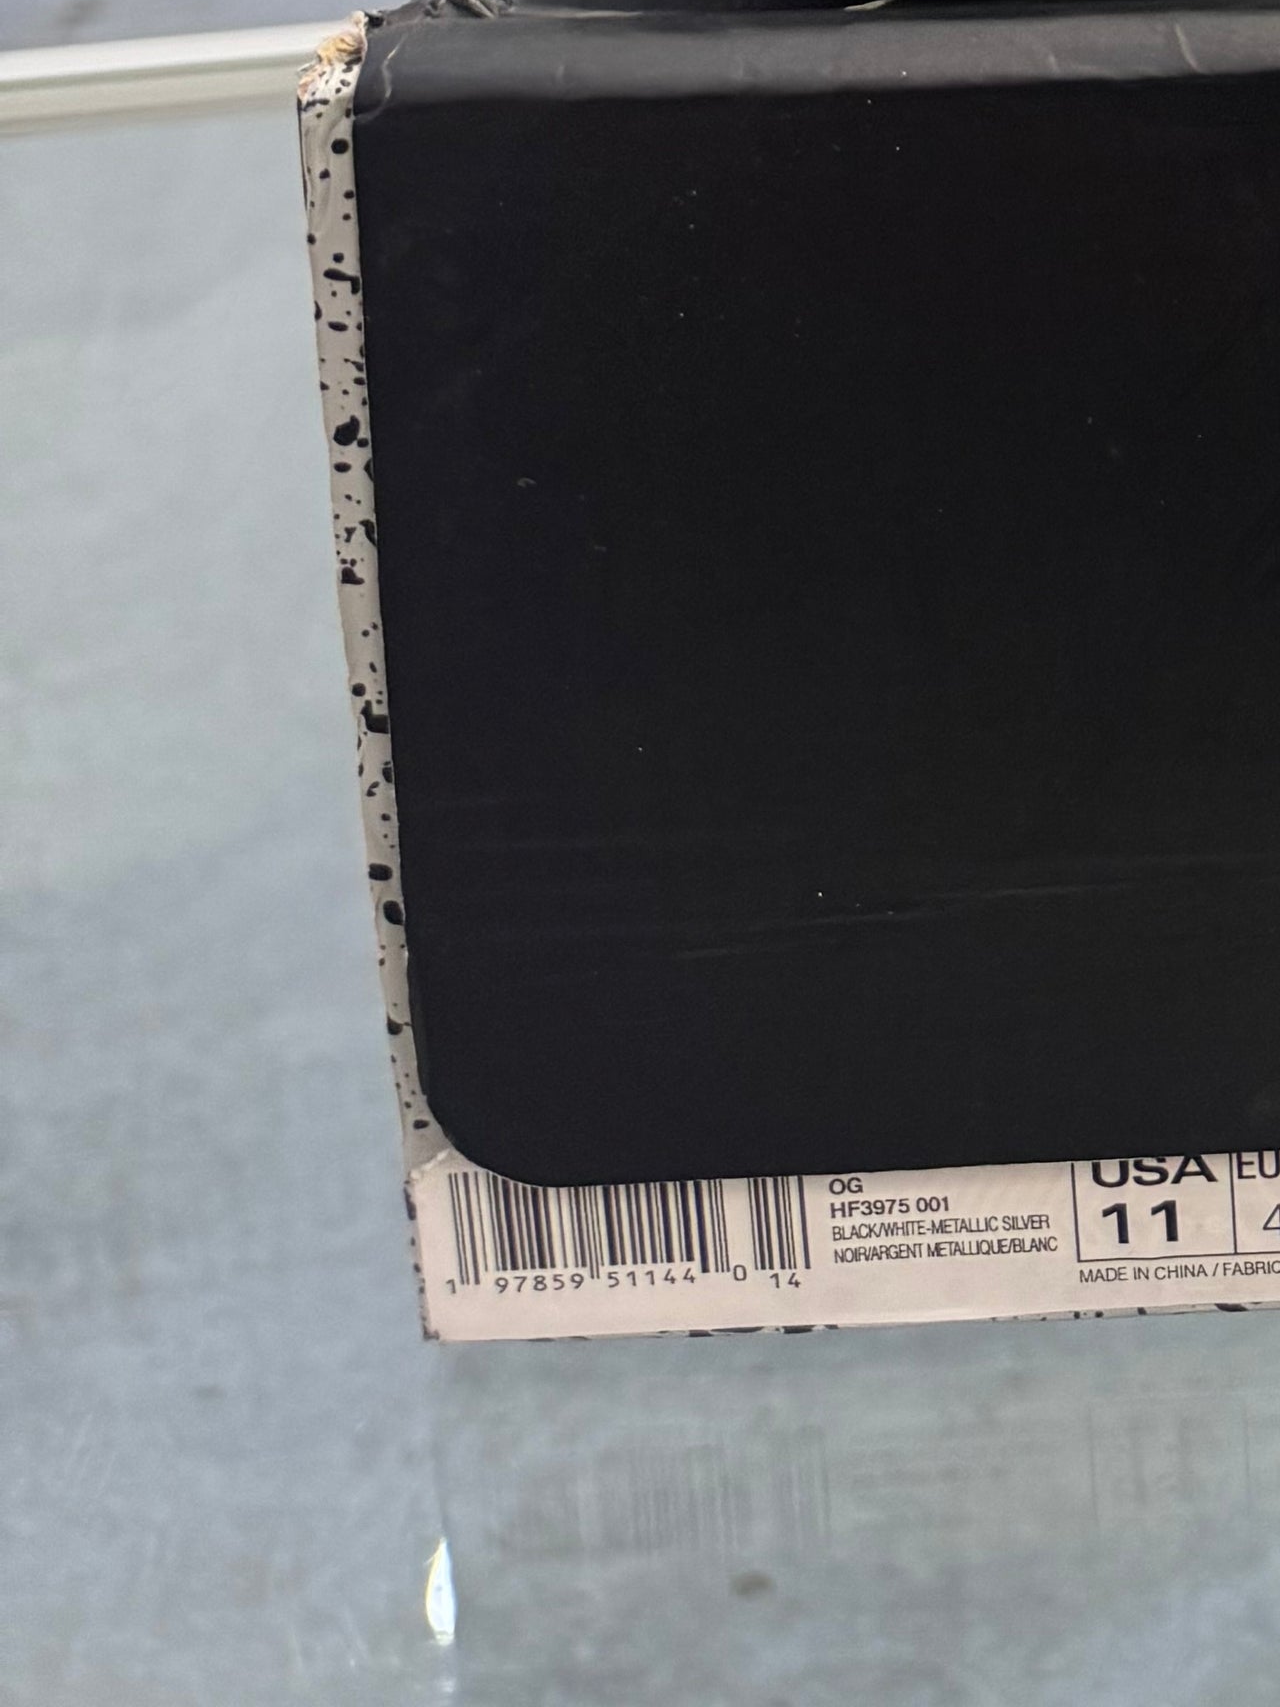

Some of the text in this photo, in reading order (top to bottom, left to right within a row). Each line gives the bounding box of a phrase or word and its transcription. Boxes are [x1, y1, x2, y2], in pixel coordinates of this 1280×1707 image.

[1091, 1155, 1219, 1187] USA
[828, 1177, 863, 1195] OG
[830, 1196, 949, 1219] HF3975 001
[832, 1214, 1050, 1241] BLACK/WHITE-METALLIC SILVER
[1102, 1200, 1178, 1244] 11
[834, 1236, 1058, 1264] NOIR/ARGENT METALLIQUE/BLANC
[1079, 1267, 1129, 1283] MADE
[1133, 1266, 1150, 1281] IN
[1154, 1264, 1209, 1280] CHINA
